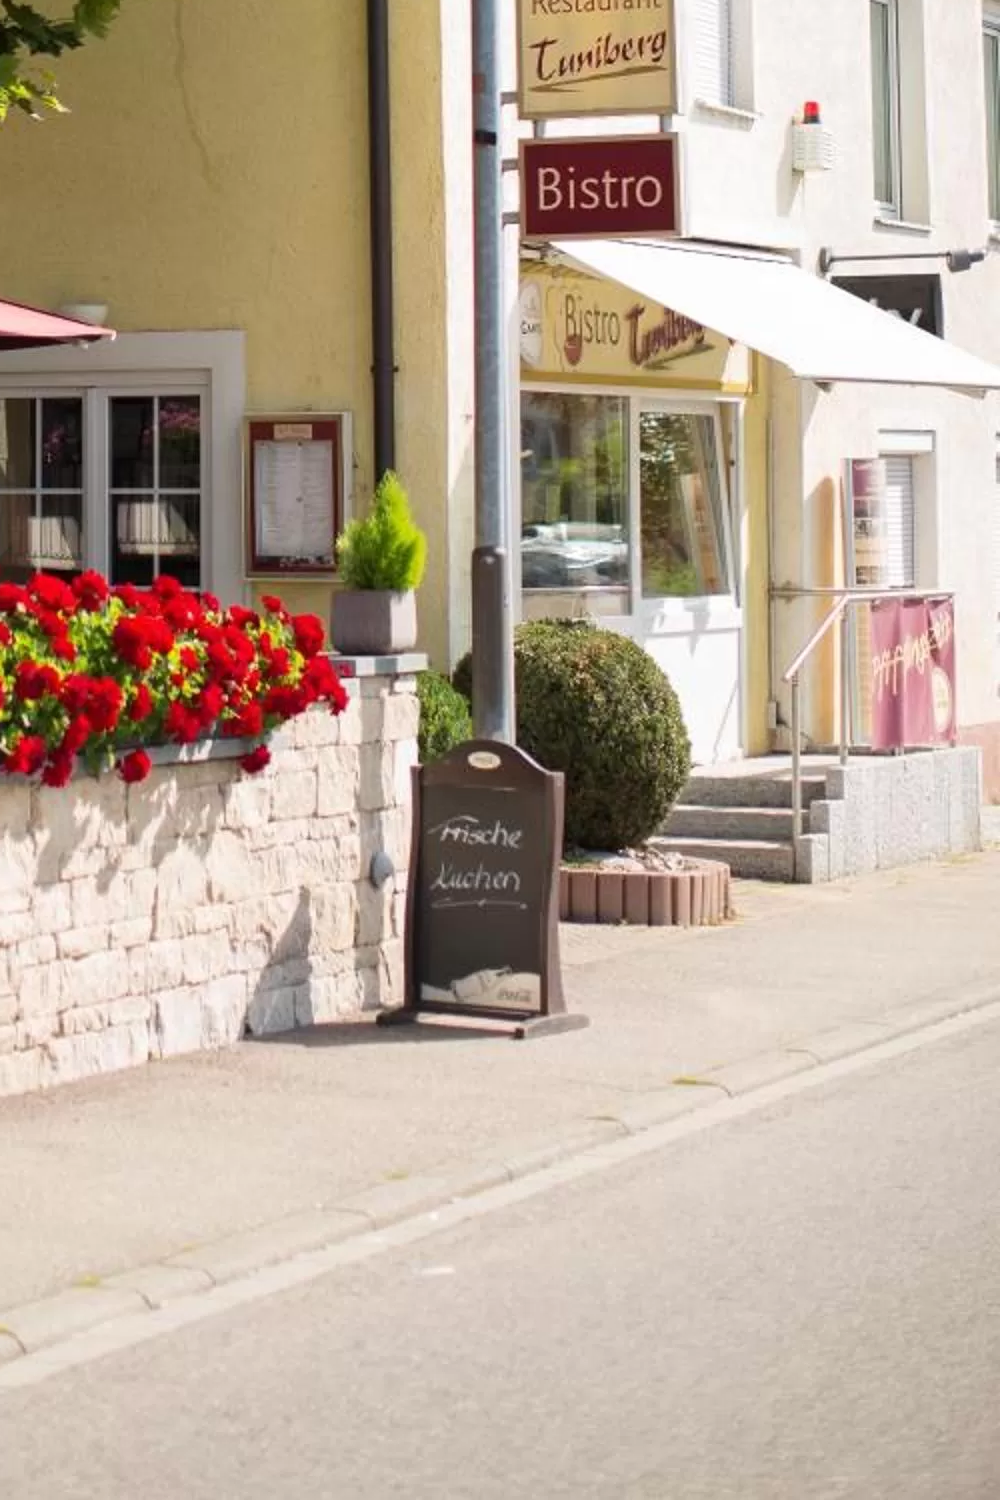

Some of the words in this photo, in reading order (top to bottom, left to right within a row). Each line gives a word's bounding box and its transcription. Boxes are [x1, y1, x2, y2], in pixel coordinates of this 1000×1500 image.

[528, 29, 668, 82] Tuniberg
[537, 166, 663, 211] Bistro
[564, 294, 621, 346] Bistro
[428, 815, 523, 849] Frische
